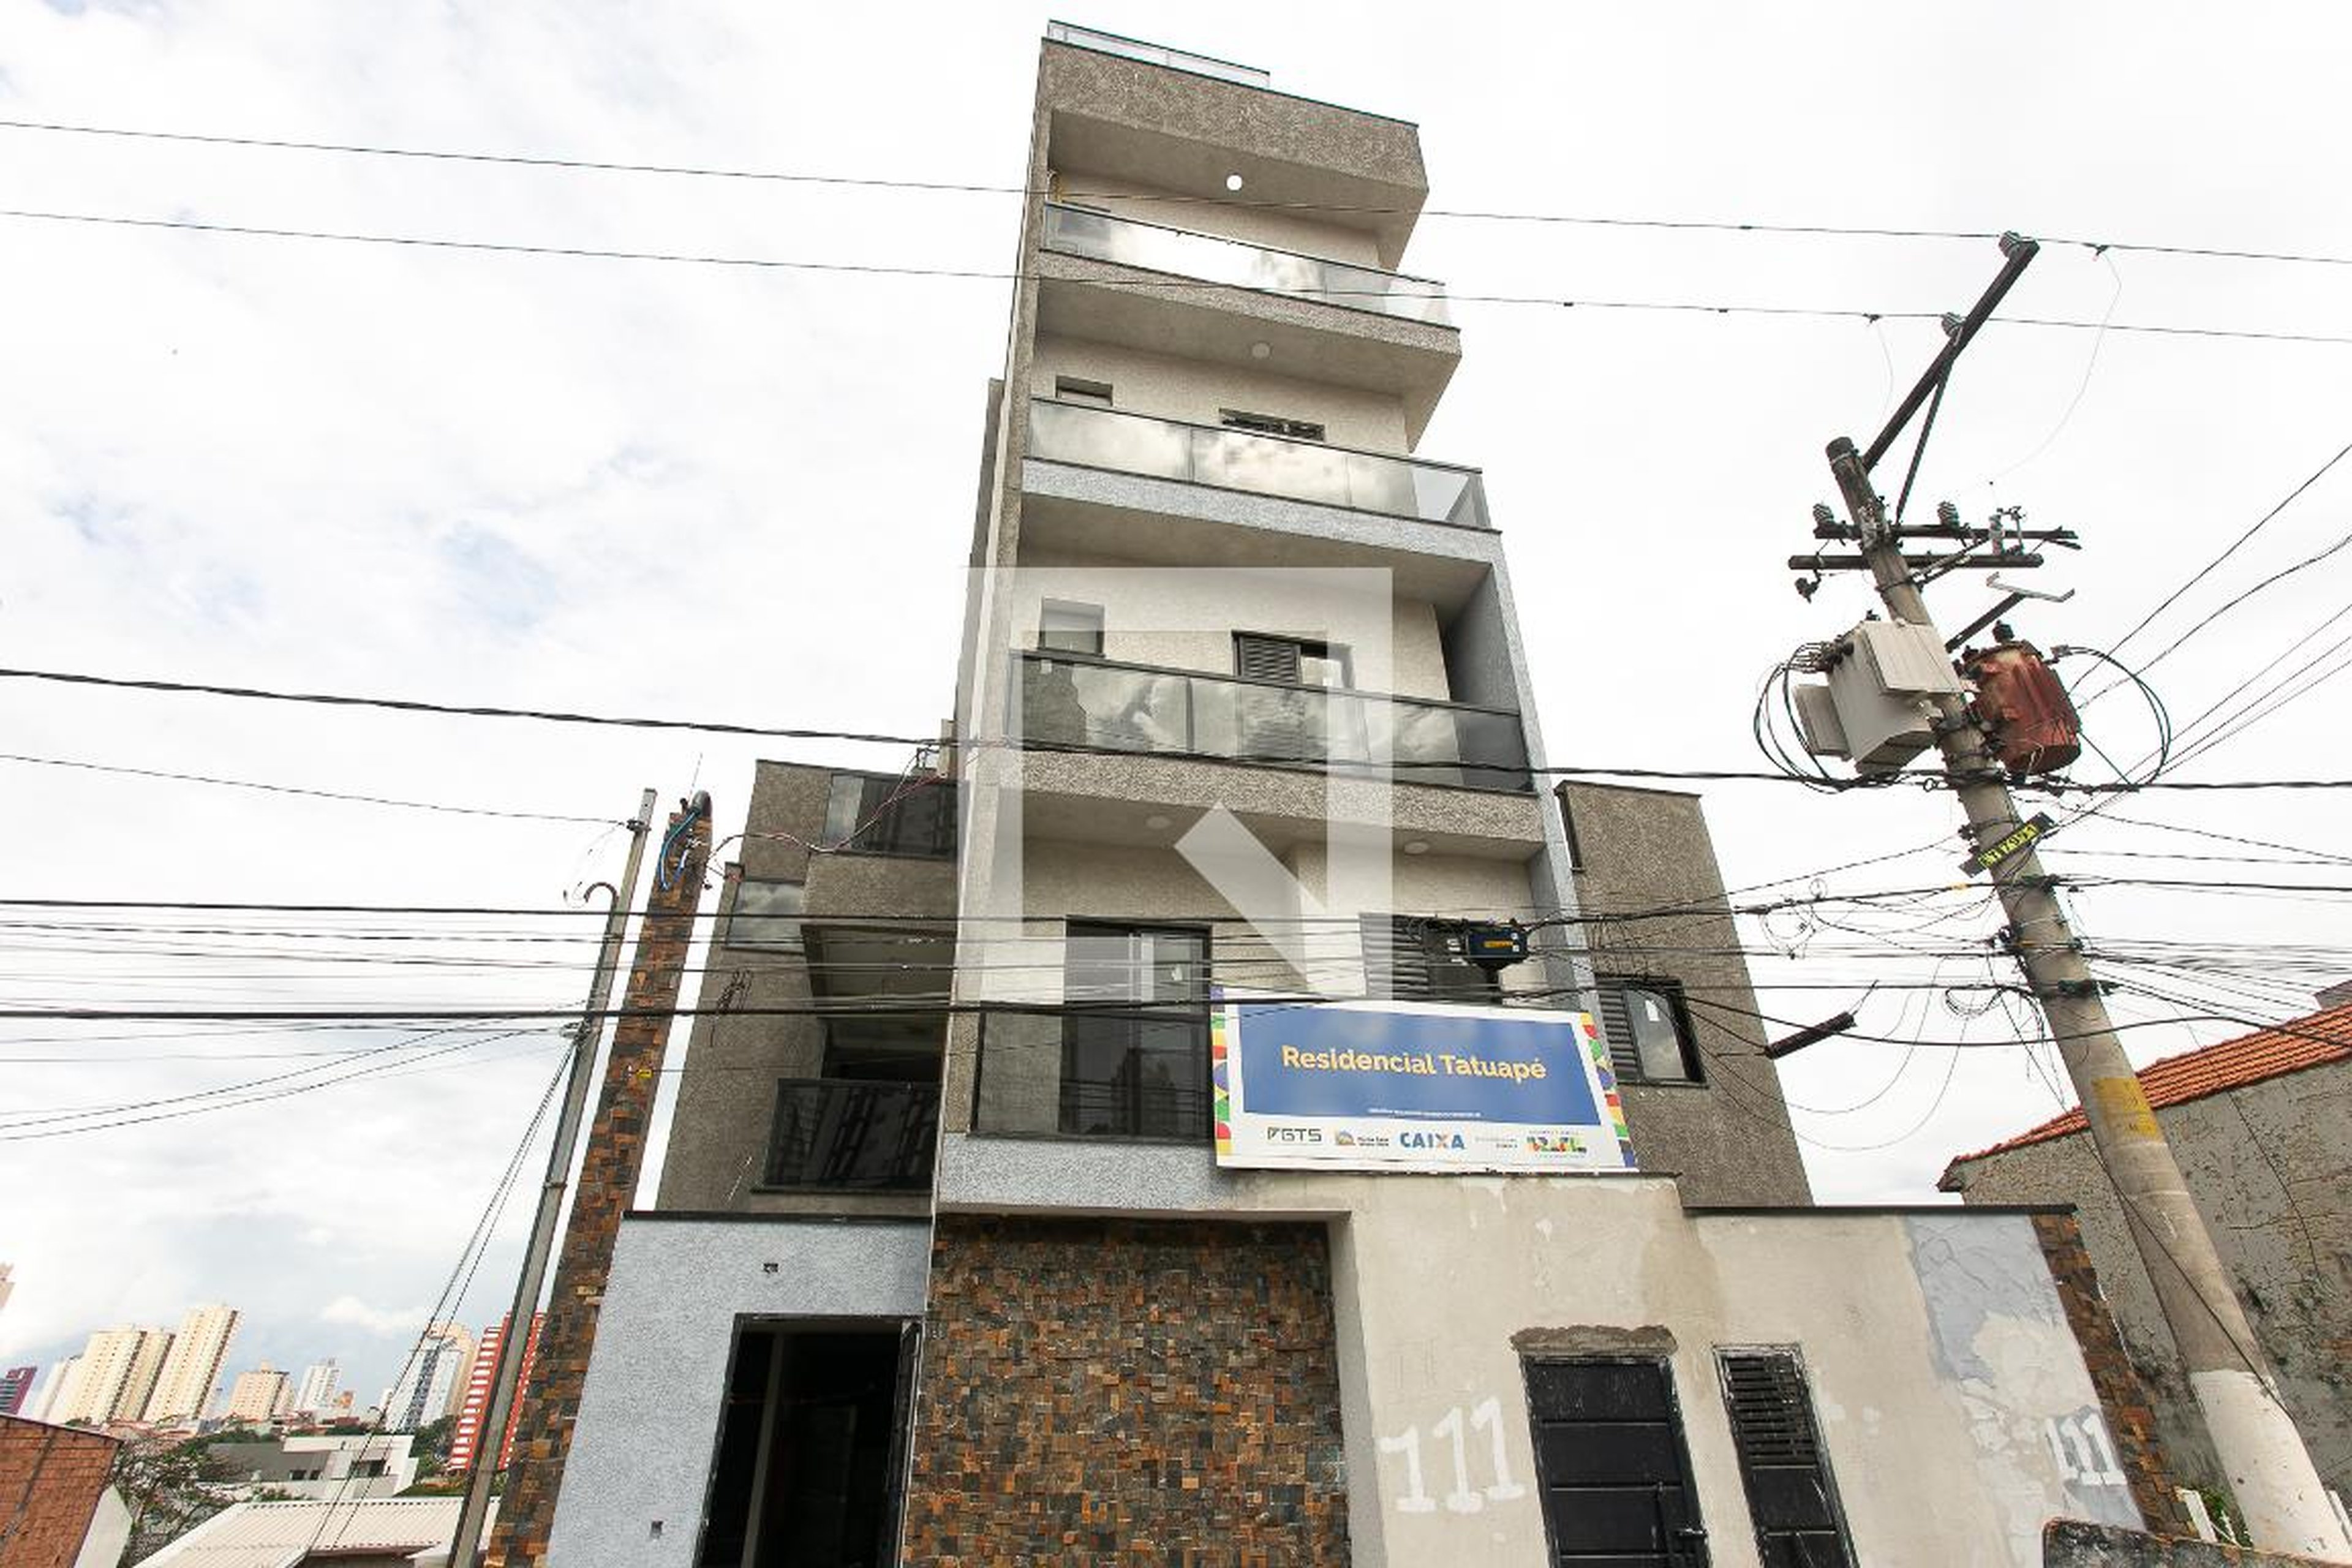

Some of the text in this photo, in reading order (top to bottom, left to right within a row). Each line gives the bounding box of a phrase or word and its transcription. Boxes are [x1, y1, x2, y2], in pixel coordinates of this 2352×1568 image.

[1281, 1045, 1547, 1085] Residencial Tatuapé
[1400, 1132, 1465, 1150] CAIXA
[1377, 1396, 1526, 1513] 111
[2045, 1412, 2128, 1485] 111
